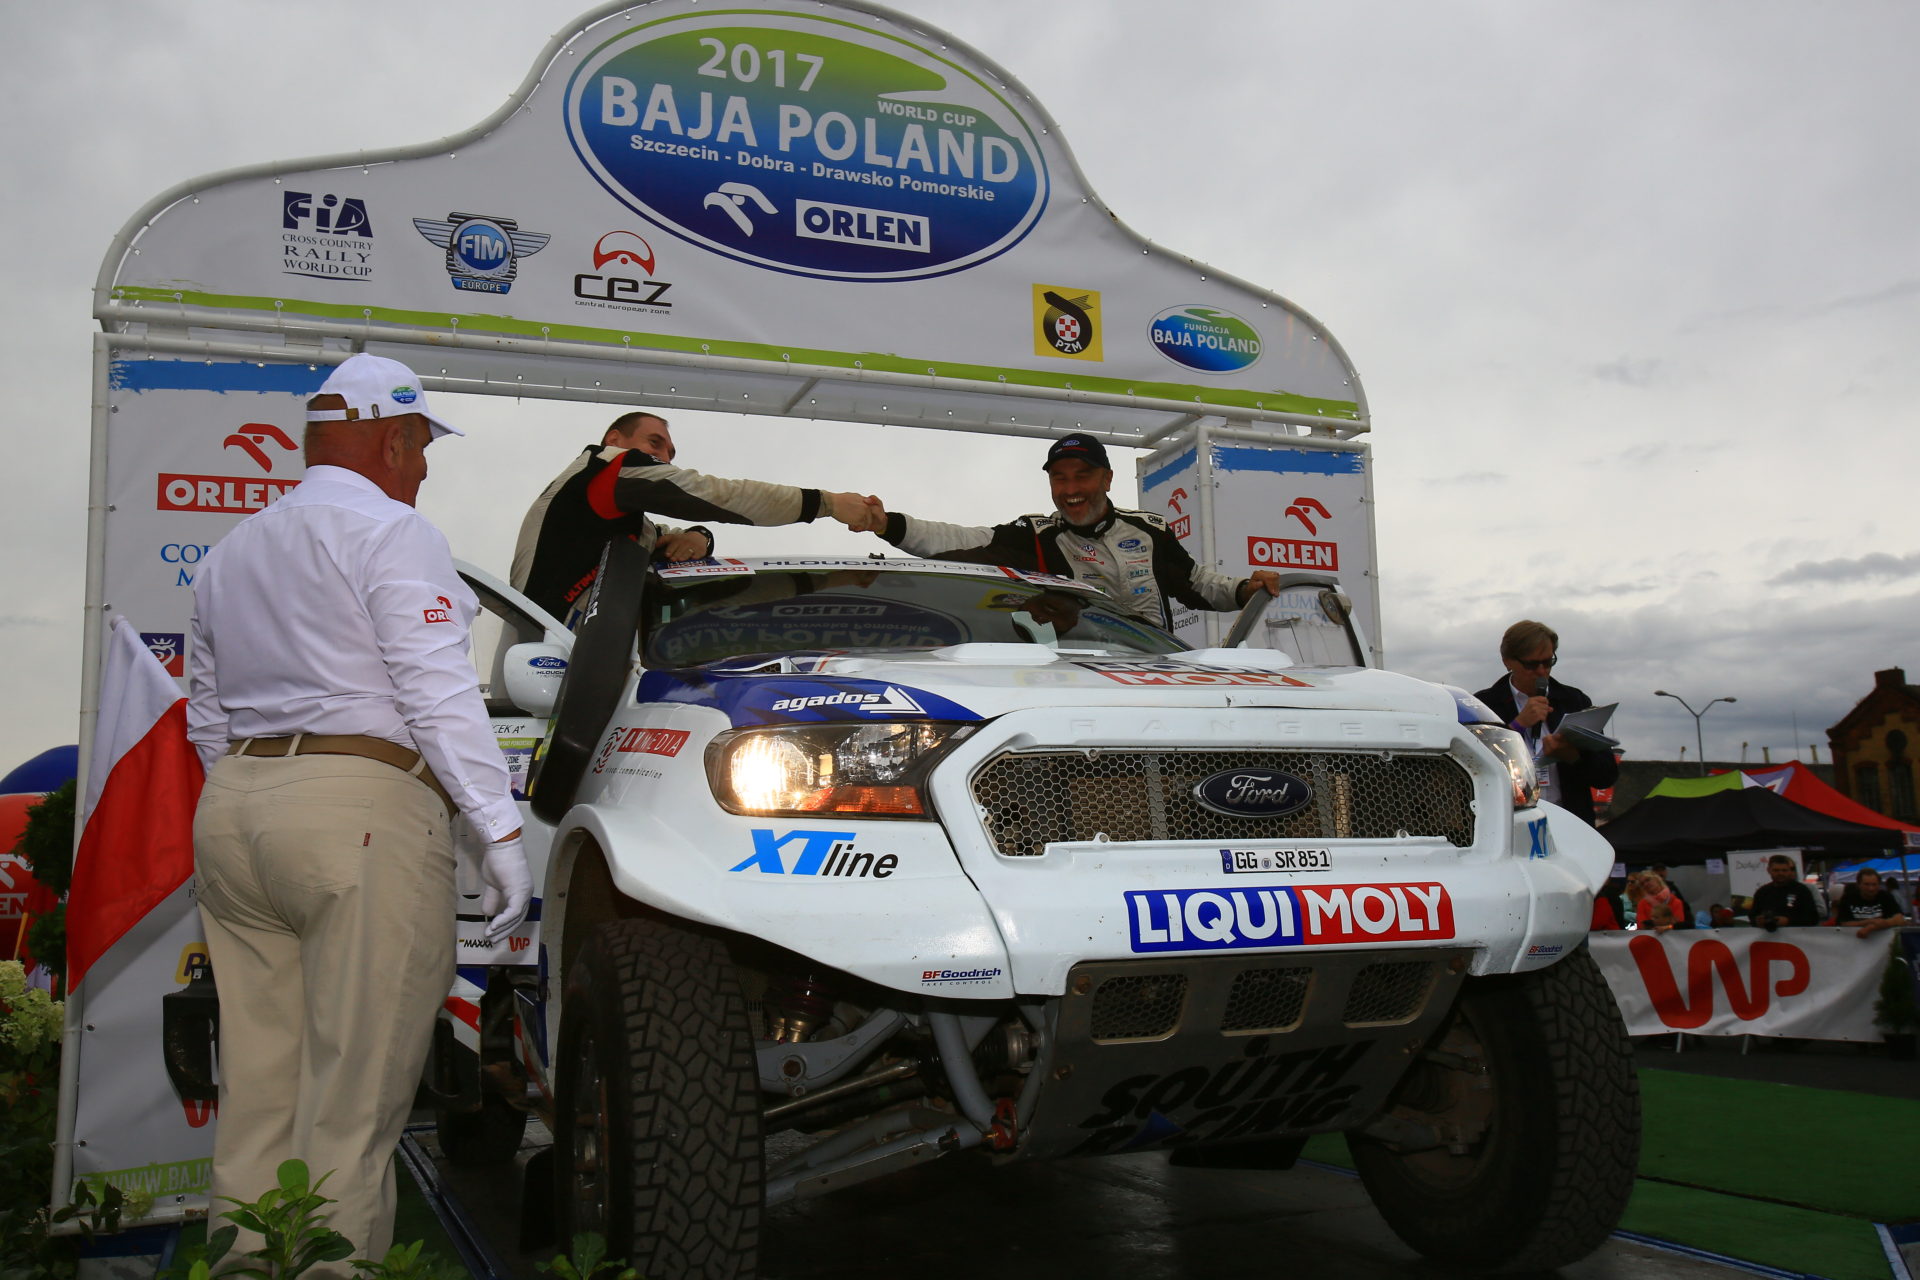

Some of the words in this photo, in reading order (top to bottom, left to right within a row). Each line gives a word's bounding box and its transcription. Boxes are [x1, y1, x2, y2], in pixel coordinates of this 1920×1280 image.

[696, 36, 825, 92] 2017
[877, 100, 938, 123] WORLD
[942, 111, 977, 127] CUP
[601, 75, 759, 148] BAJA
[778, 103, 1020, 184] POLAND
[629, 134, 720, 162] Szczecin
[736, 150, 795, 173] Dobra
[812, 162, 894, 188] Drawsko
[898, 174, 996, 202] Pomorskie
[803, 206, 922, 247] ORLEN
[282, 233, 318, 246] CROSS
[319, 238, 374, 251] COUNTRY
[460, 233, 505, 261] FIM
[284, 245, 372, 264] RALLY
[283, 258, 340, 275] WORLD
[342, 265, 373, 277] CUP
[461, 278, 502, 293] EUROPE
[574, 300, 606, 309] central
[607, 304, 648, 313] european
[650, 308, 671, 316] zone
[1184, 322, 1231, 336] FUNDACJA
[1055, 338, 1084, 353] PZM
[1153, 328, 1194, 348] BAJA
[1196, 332, 1261, 356] POLAND
[1252, 541, 1334, 567] ORLEN
[536, 657, 562, 668] Ford
[1109, 672, 1292, 686] MOLY
[772, 691, 882, 713] agados
[1070, 719, 1424, 743] RANGER
[1228, 773, 1290, 805] Ford
[728, 828, 899, 879] XTline
[1235, 851, 1258, 869] GG
[1132, 889, 1297, 945] LIQUI
[1302, 885, 1443, 936] MOLY
[508, 936, 530, 953] WP
[922, 967, 1002, 980] BFGoodrich
[949, 979, 992, 987] CONTROL
[1628, 933, 1811, 1029] WP
